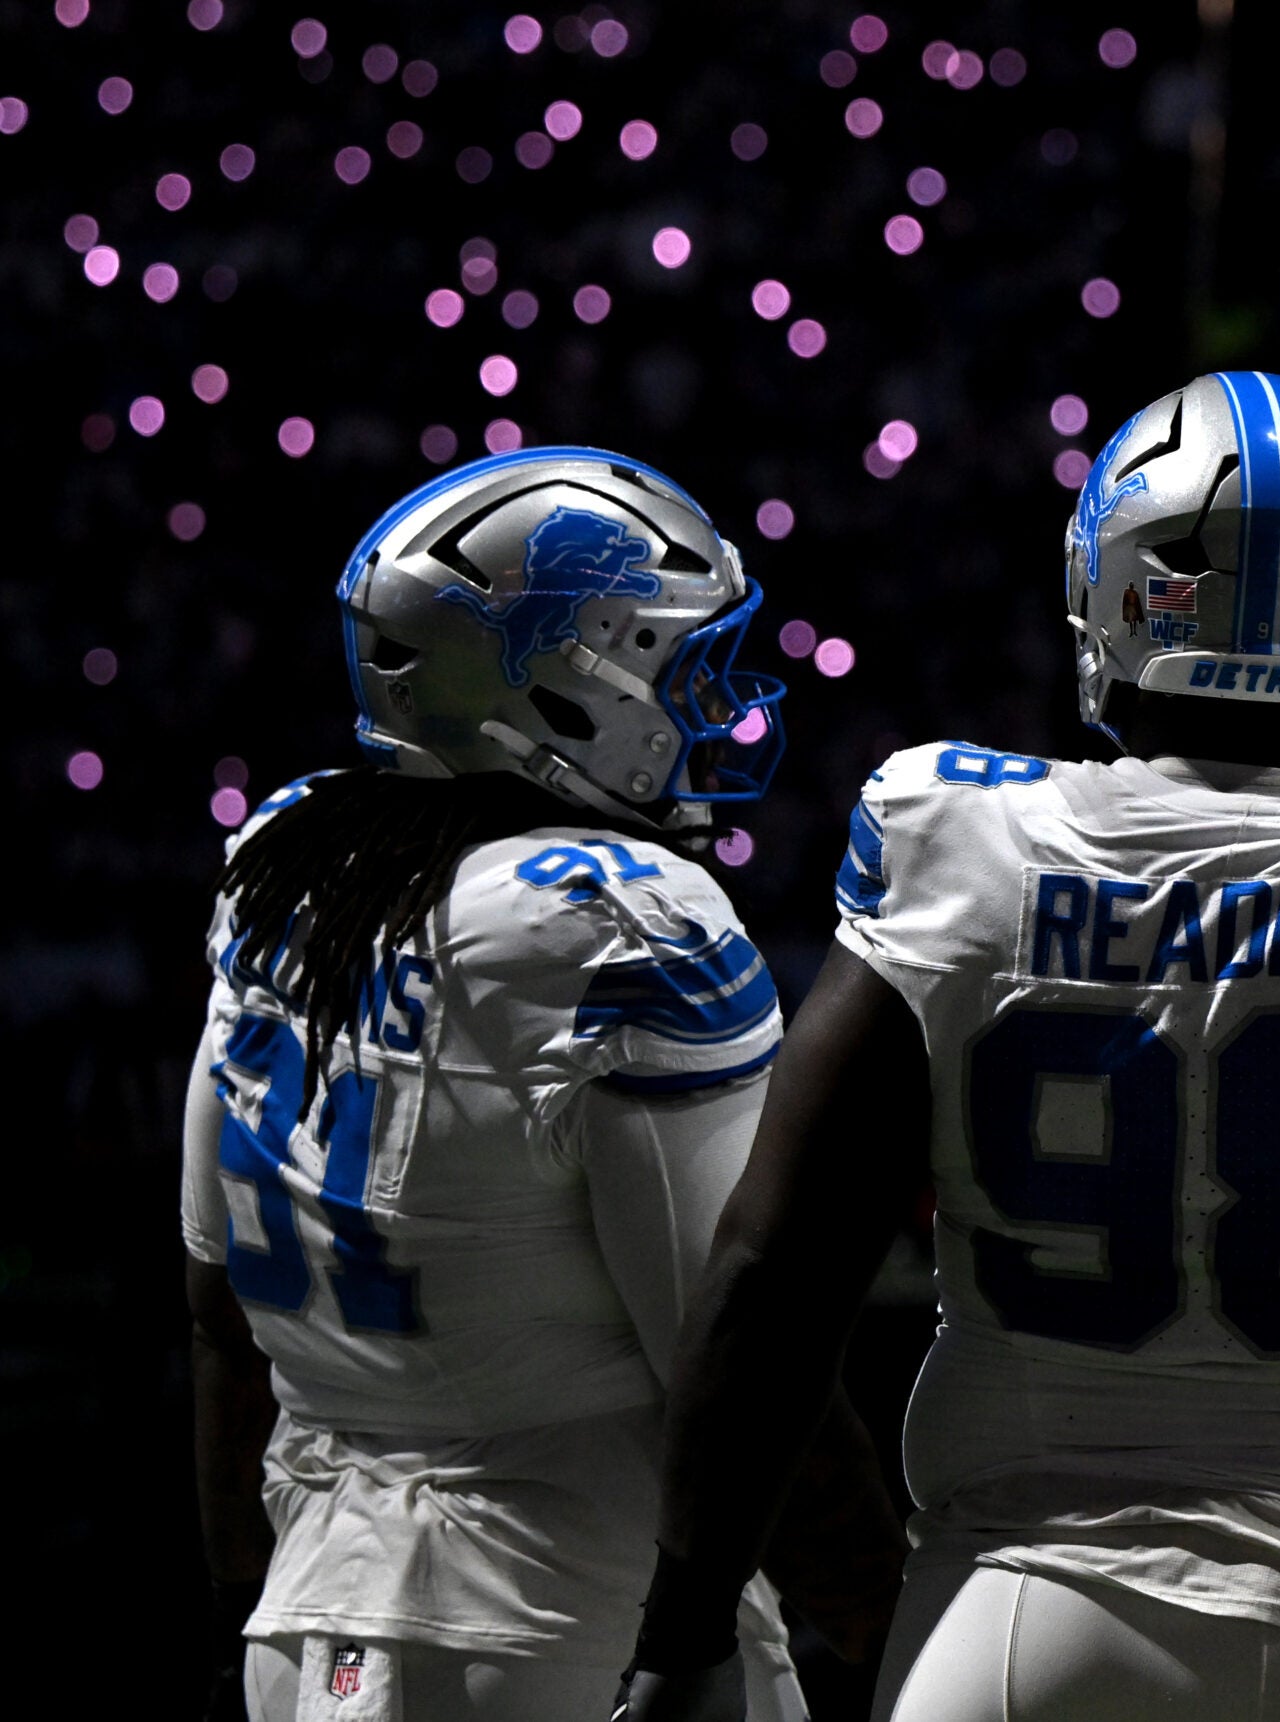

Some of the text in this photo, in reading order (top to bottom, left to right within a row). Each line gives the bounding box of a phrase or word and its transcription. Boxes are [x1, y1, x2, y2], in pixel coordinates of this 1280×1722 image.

[1150, 619, 1198, 642] WCF
[514, 838, 665, 905] 91
[210, 1008, 430, 1338] 91
[333, 1667, 361, 1695] NFL
